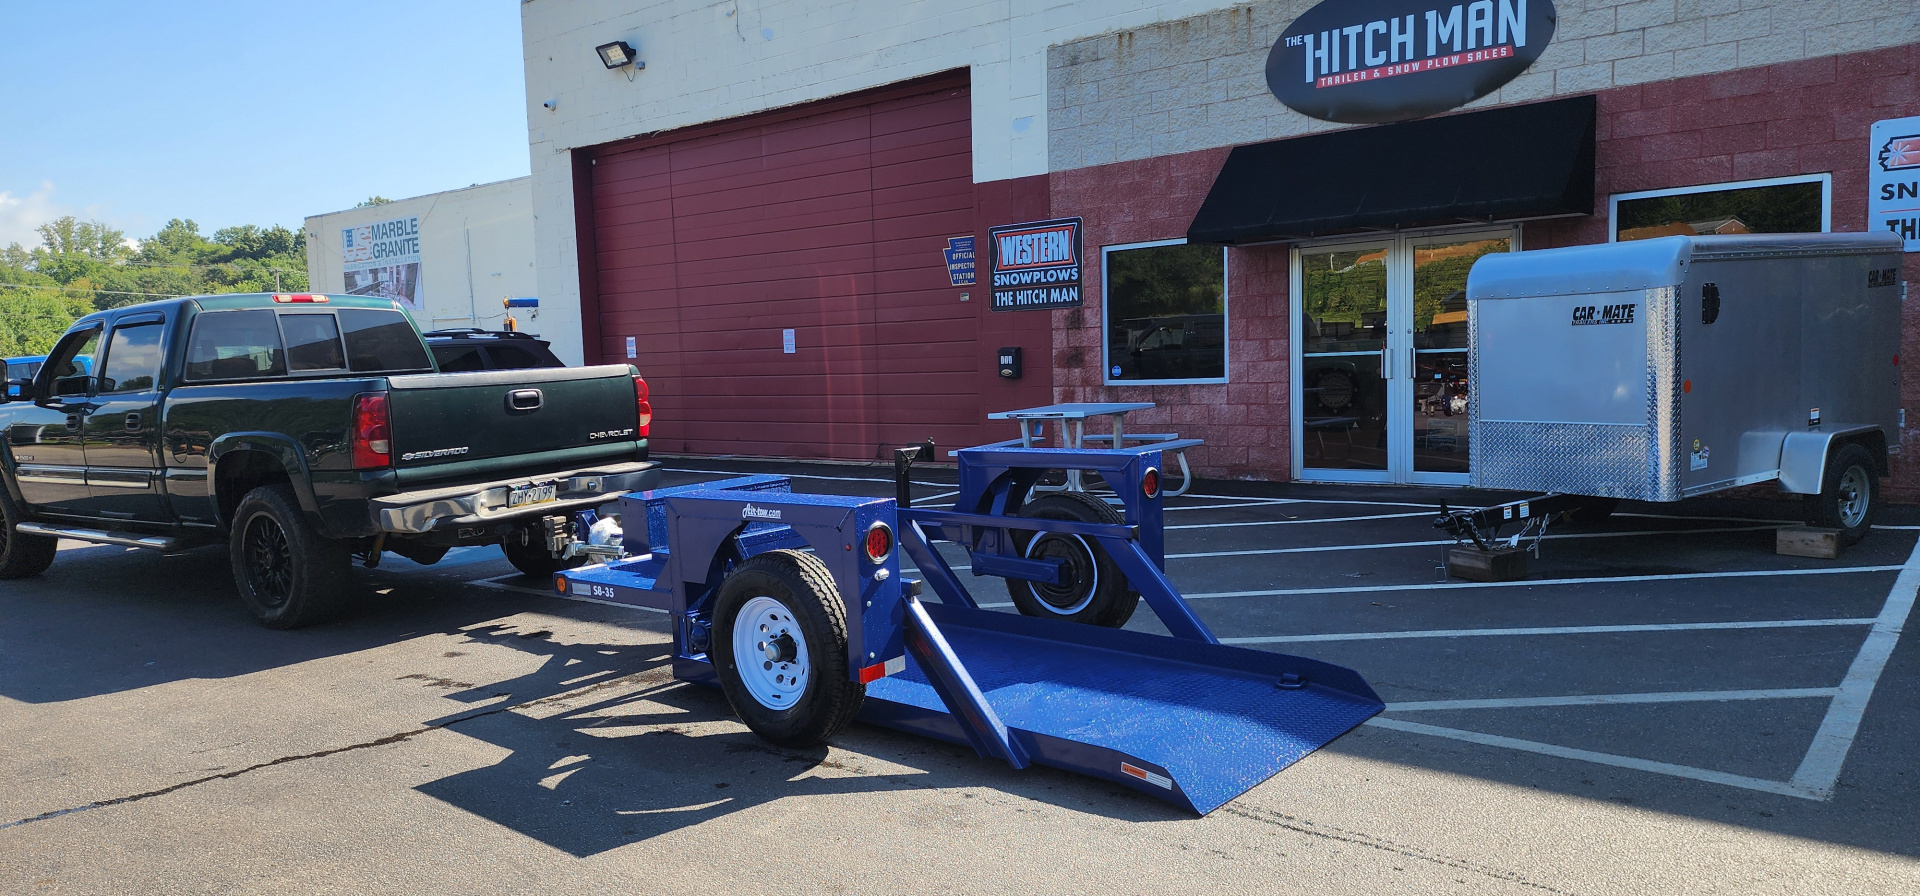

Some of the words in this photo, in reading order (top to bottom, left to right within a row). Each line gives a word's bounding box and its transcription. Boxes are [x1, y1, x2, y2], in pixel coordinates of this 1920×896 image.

[1285, 35, 1303, 47] THE
[1304, 14, 1414, 83] HITCH
[1425, 0, 1527, 56] MAN
[1321, 71, 1366, 86] TRAILER
[1373, 69, 1380, 78] &
[1388, 62, 1420, 75] SNOW
[1427, 55, 1460, 69] PLOW
[1467, 47, 1507, 62] SALES
[371, 217, 418, 241] MARBLE
[1886, 218, 1920, 240] TH
[342, 226, 373, 263] US
[372, 237, 420, 259] GRANITE
[1001, 230, 1069, 266] WESTERN
[382, 255, 420, 266] INSTALLATION
[952, 251, 975, 260] OFFICIAL
[953, 272, 975, 280] STATION
[994, 268, 1078, 286] SNOWPLOWS
[995, 292, 1013, 306] THE
[1016, 289, 1047, 305] HITCH
[1050, 287, 1078, 303] MAN
[590, 429, 633, 439] CHEVROLET
[414, 446, 469, 459] SILVERADO
